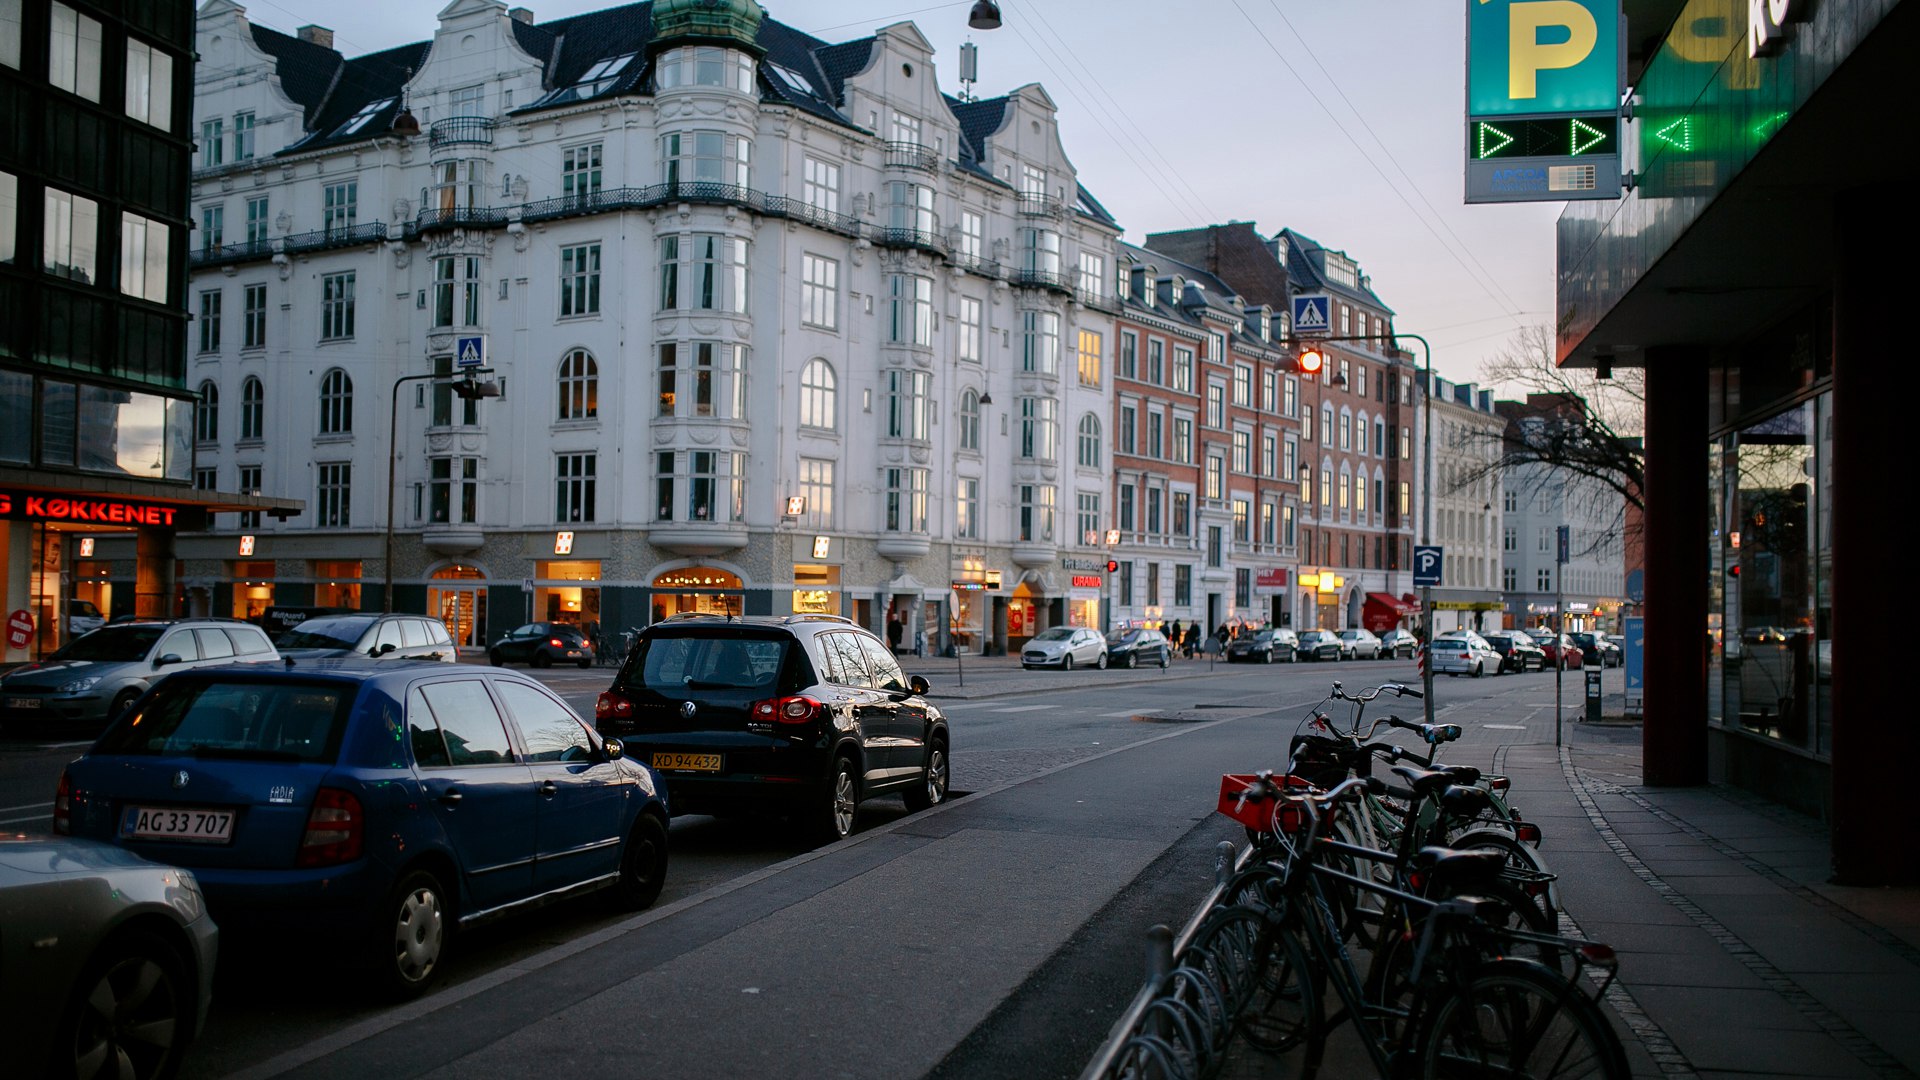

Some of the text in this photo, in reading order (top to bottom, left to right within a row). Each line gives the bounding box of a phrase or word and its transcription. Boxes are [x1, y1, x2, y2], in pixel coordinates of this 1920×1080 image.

[1509, 1, 1598, 100] P
[26, 497, 177, 525] KØKKENET
[1421, 555, 1435, 573] P
[1257, 568, 1275, 577] HEY
[1072, 576, 1102, 587] URANIA
[654, 754, 719, 769] XD 94 432
[270, 785, 294, 799] FABIA
[137, 812, 230, 835] AG 33 707
